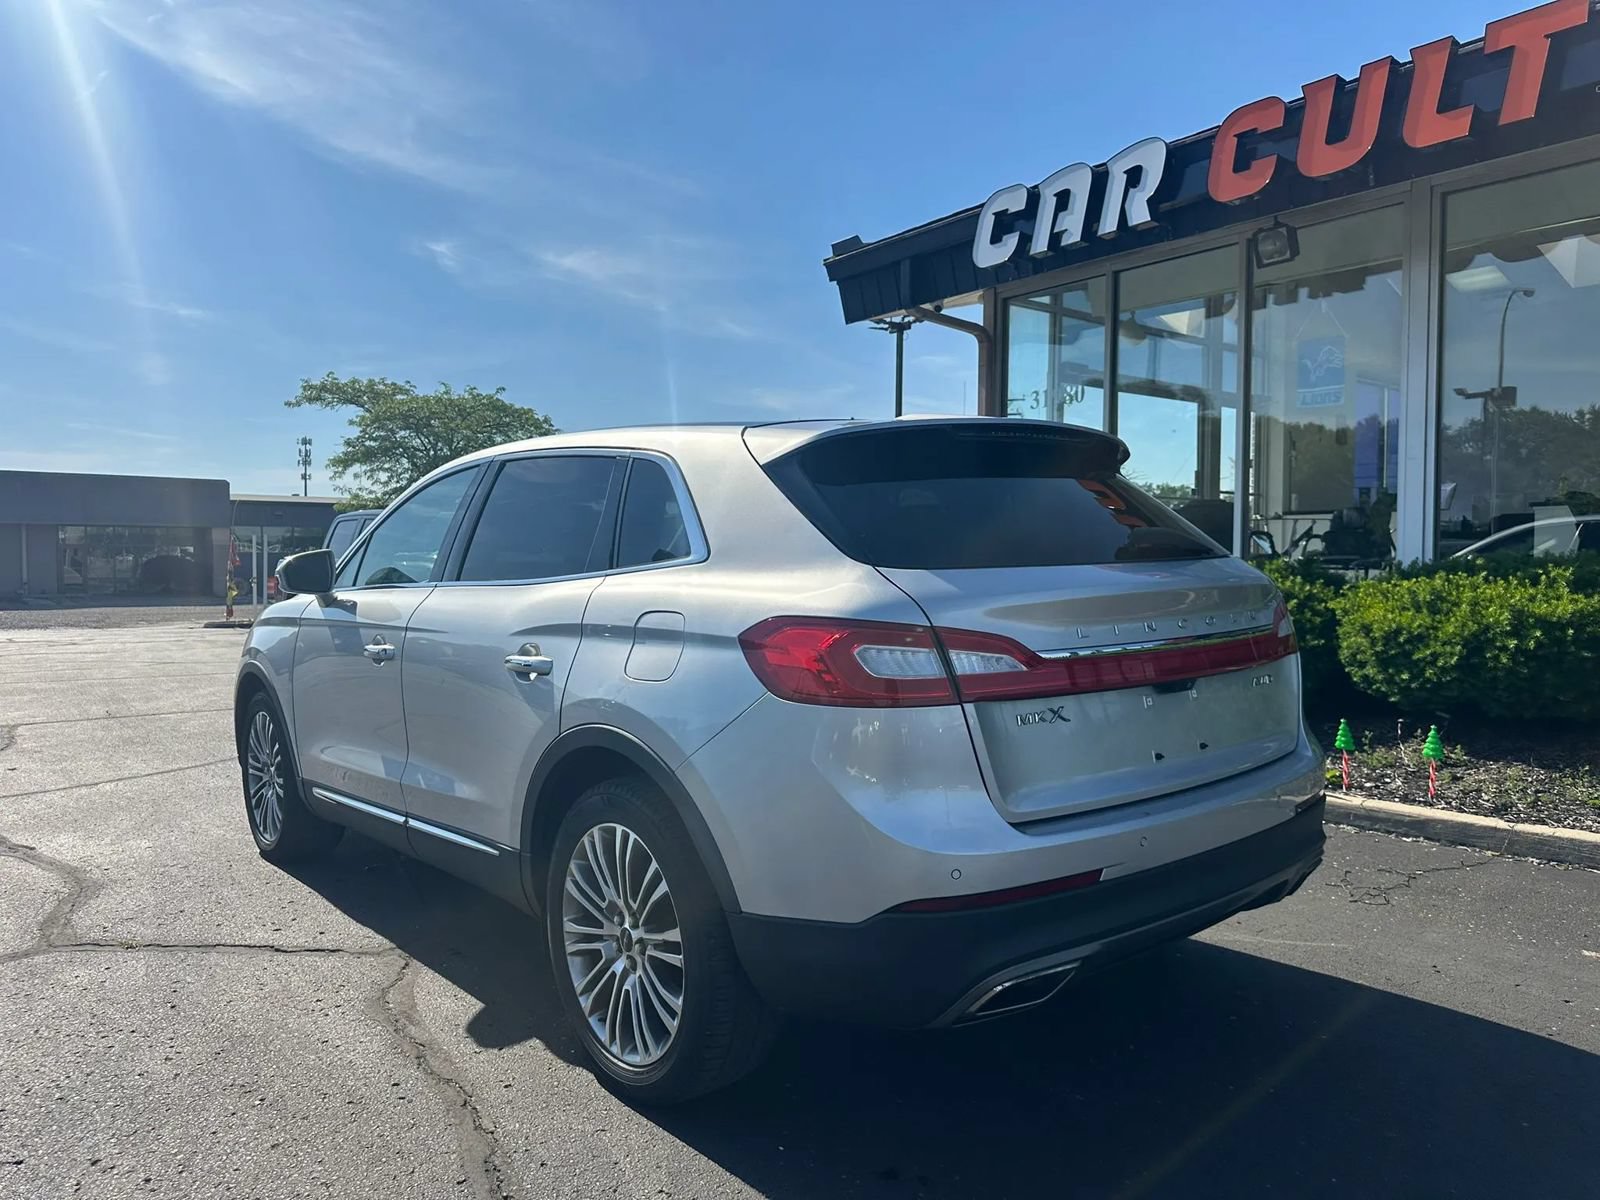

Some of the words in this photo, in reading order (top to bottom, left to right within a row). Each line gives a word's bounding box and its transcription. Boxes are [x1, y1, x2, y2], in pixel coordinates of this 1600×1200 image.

[972, 136, 1168, 269] CAR
[1207, 0, 1590, 204] CULT
[1076, 610, 1258, 640] LINCOLN
[1016, 705, 1071, 727] MKX
